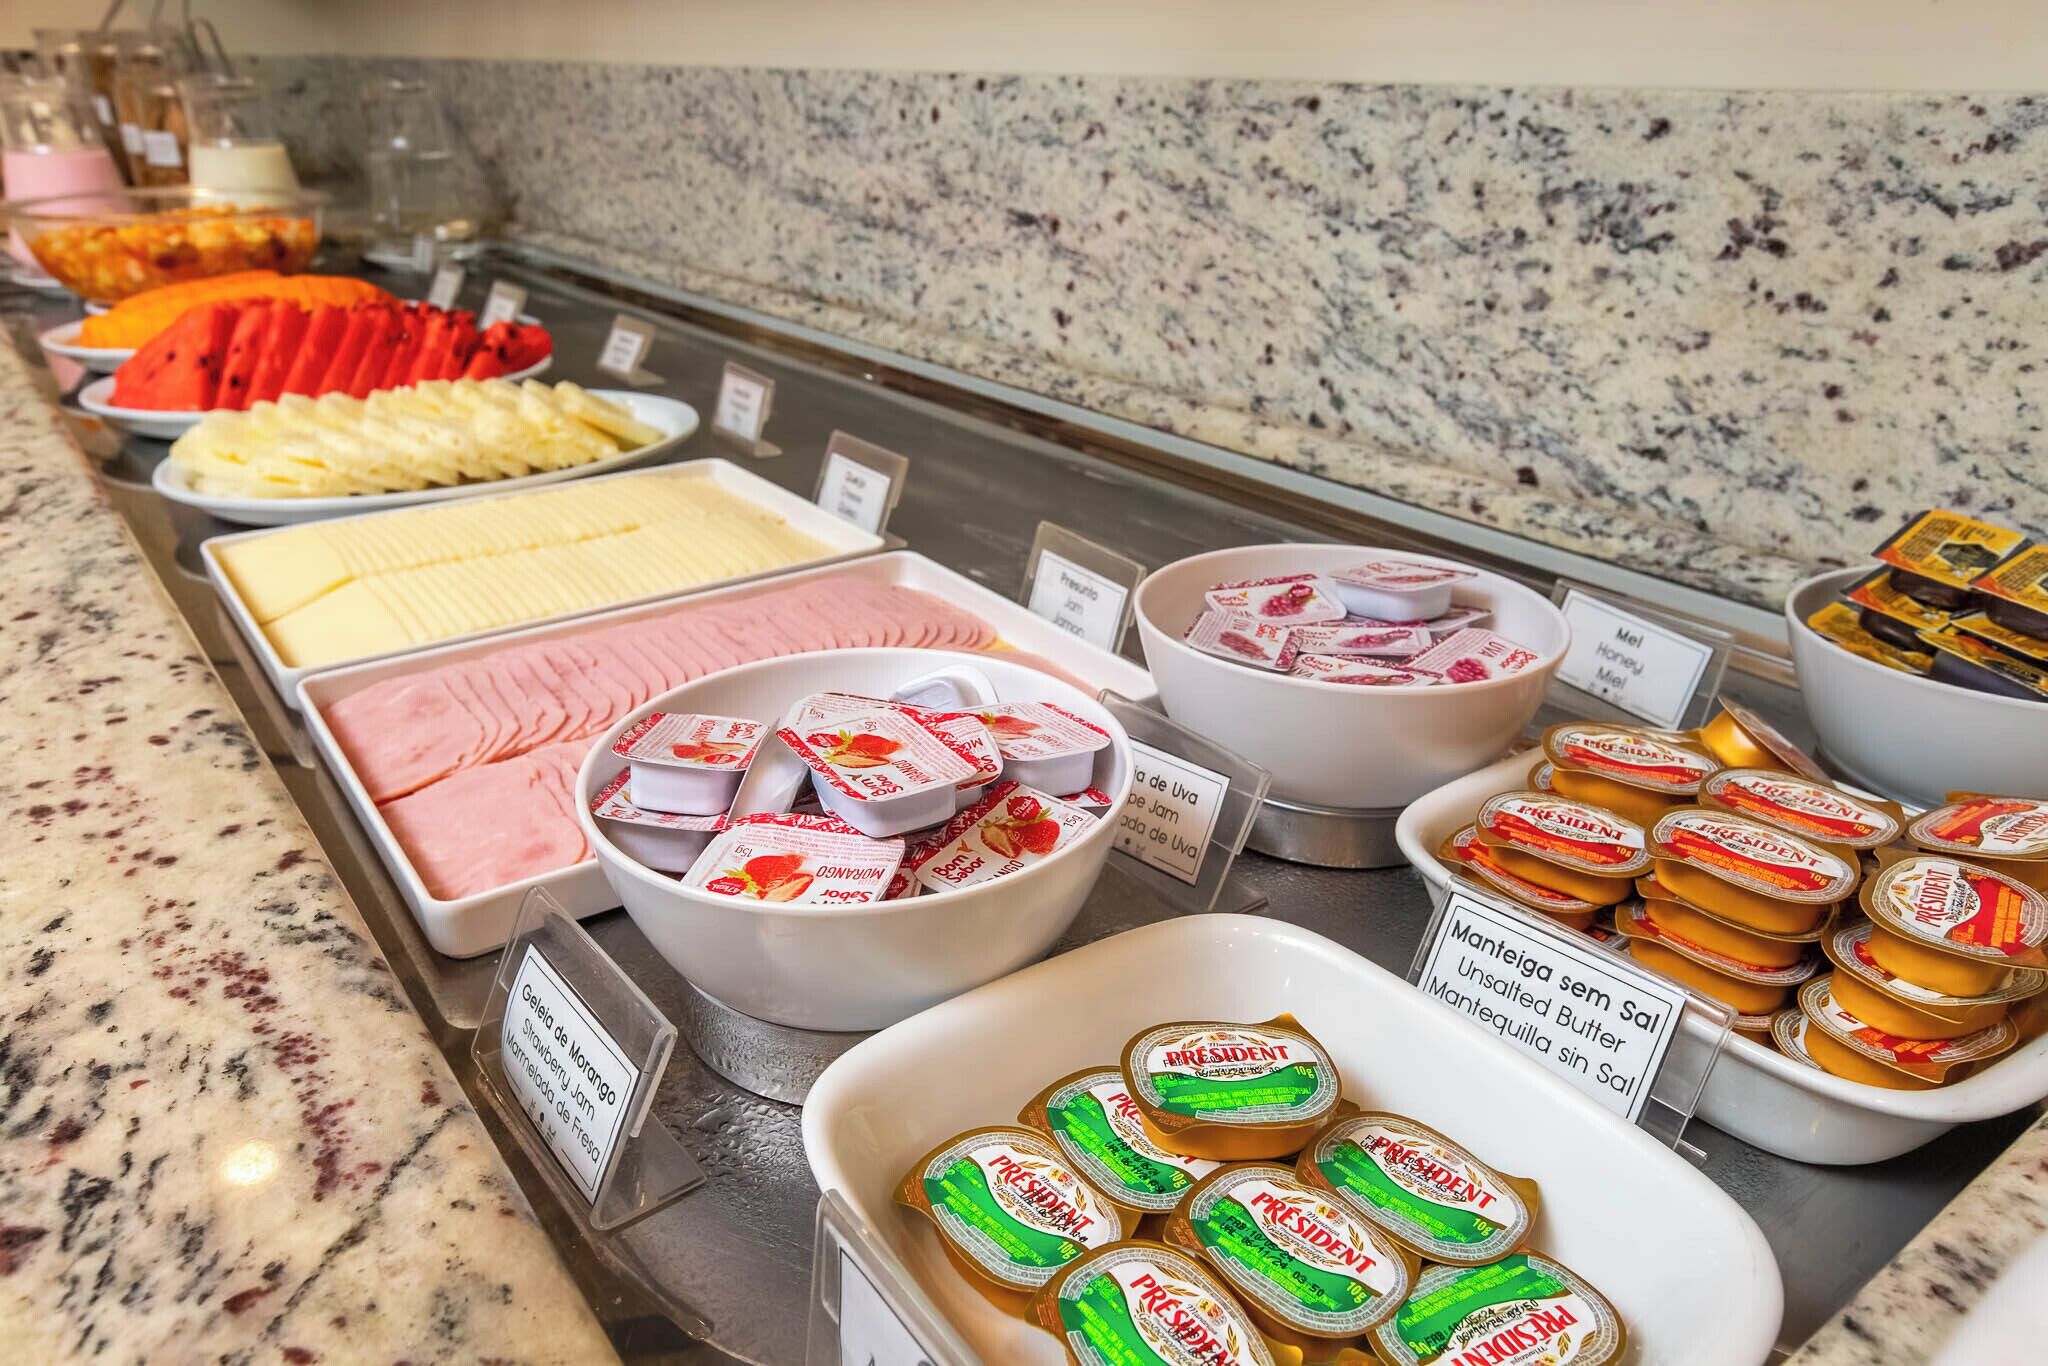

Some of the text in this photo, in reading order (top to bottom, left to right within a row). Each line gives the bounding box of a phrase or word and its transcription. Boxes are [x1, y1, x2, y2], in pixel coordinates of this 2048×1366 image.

[1615, 627, 1645, 648] Mel
[1595, 641, 1645, 676] Honey
[1595, 666, 1629, 690] Miel
[1150, 774, 1167, 792] de
[1172, 782, 1199, 805] Uva
[1148, 800, 1179, 824] Jam
[735, 846, 753, 859] 15g
[1150, 826, 1168, 844] de
[1171, 834, 1199, 859] Uva
[816, 865, 886, 880] MORANGO
[932, 854, 969, 878] Bom
[946, 856, 986, 883] Sabor
[1915, 868, 1953, 928] PRÉSIDENT
[1451, 919, 1661, 1034] Manteiga sem Sal
[1457, 956, 1626, 1053] Unsalted Butter
[522, 984, 616, 1106] Geleia de Morango
[1429, 976, 1636, 1096] Mantequilla sin Sal
[522, 1018, 596, 1121] Strawberry Jam
[1166, 1045, 1288, 1068] PRÉSIDENT
[1294, 1066, 1315, 1079] 10g
[556, 1102, 570, 1124] de
[571, 1117, 601, 1164] Fresa
[1168, 1170, 1188, 1189] 10g
[1373, 1136, 1497, 1210] PRÉSIDENT
[988, 1155, 1094, 1232] PRÉSIDENT
[1250, 1191, 1377, 1274] PRÉSIDENT
[1472, 1217, 1494, 1237] 10g
[1057, 1241, 1076, 1260] 10g
[1346, 1281, 1368, 1304] 10g
[1130, 1274, 1242, 1366] PRÉSIDEN
